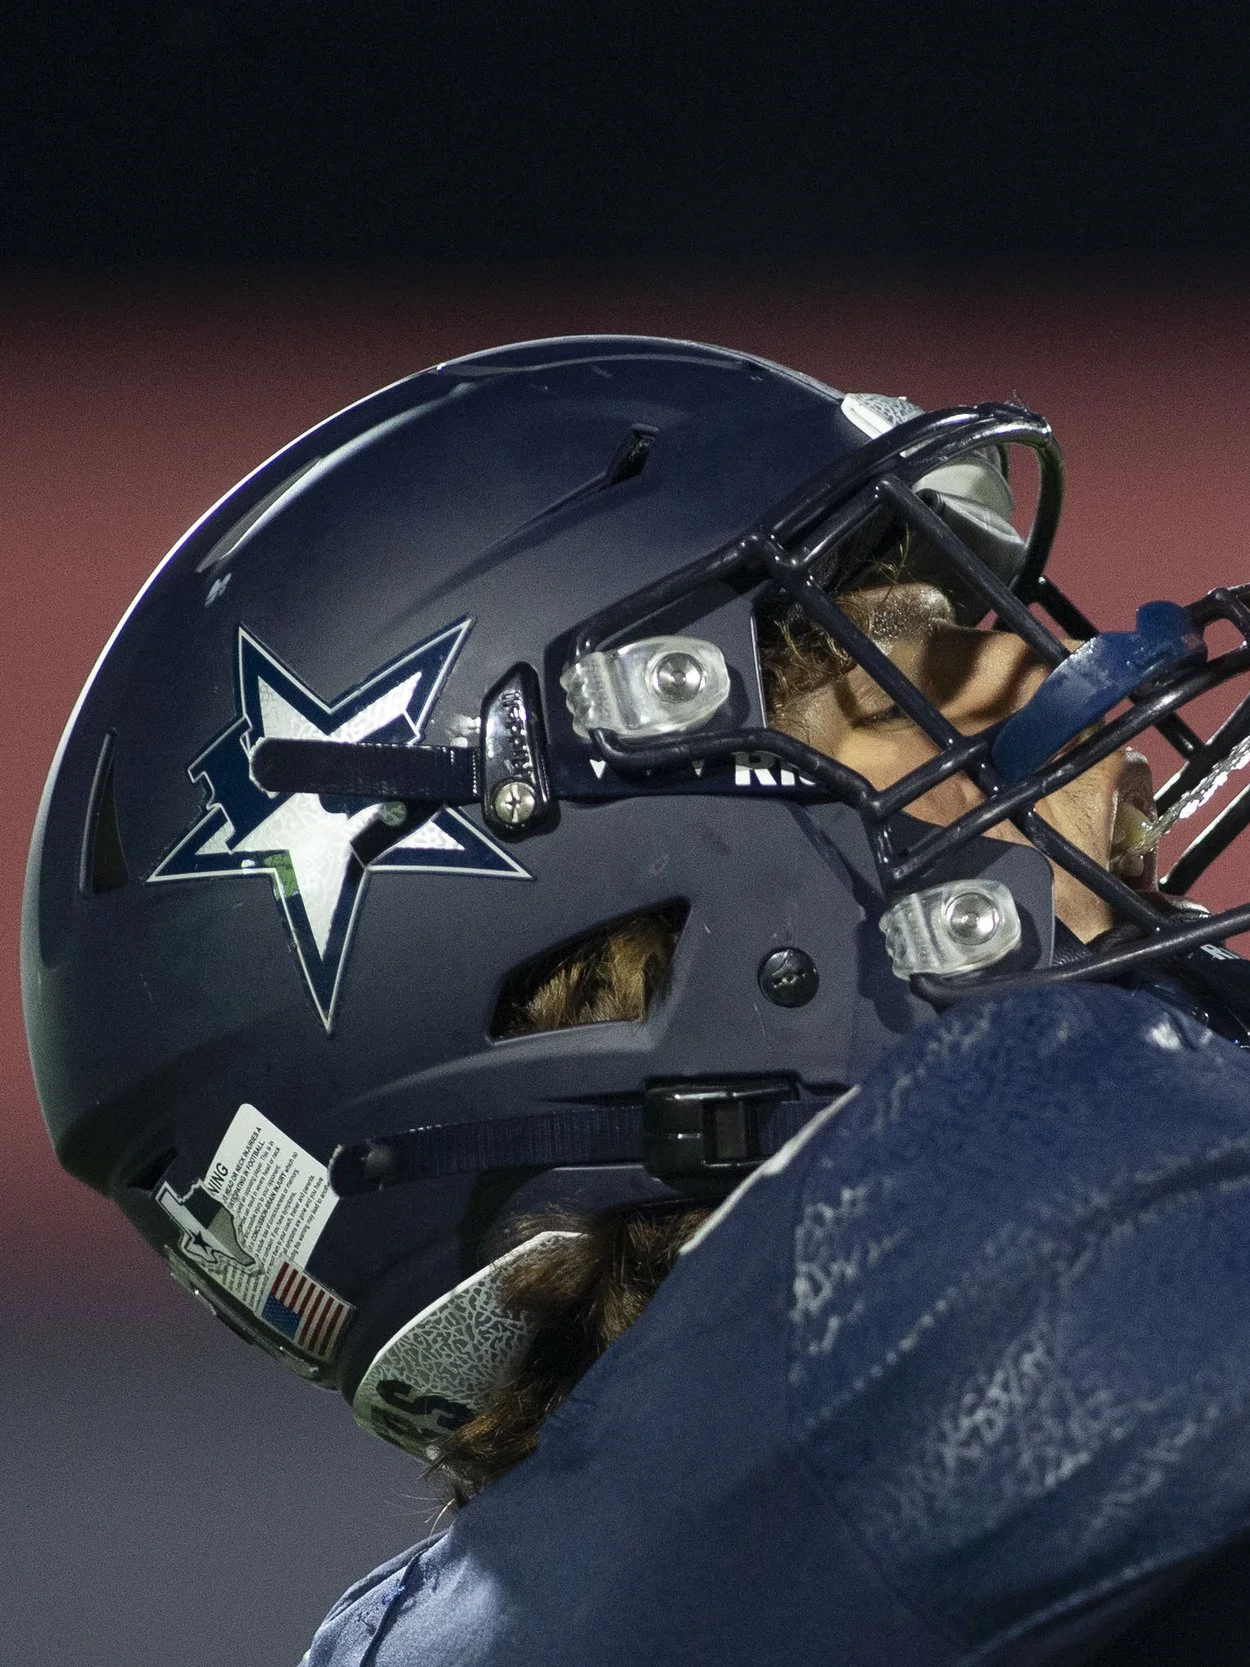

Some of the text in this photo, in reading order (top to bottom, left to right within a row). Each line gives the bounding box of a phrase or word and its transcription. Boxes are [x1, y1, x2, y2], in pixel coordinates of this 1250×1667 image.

[224, 1179, 235, 1196] HEAD
[235, 1156, 246, 1173] NECK
[242, 1130, 259, 1158] INJURIES
[262, 1186, 271, 1199] your
[273, 1171, 286, 1193] INJURY
[304, 1197, 312, 1209] and
[279, 1230, 288, 1243] your
[297, 1191, 305, 1203] and
